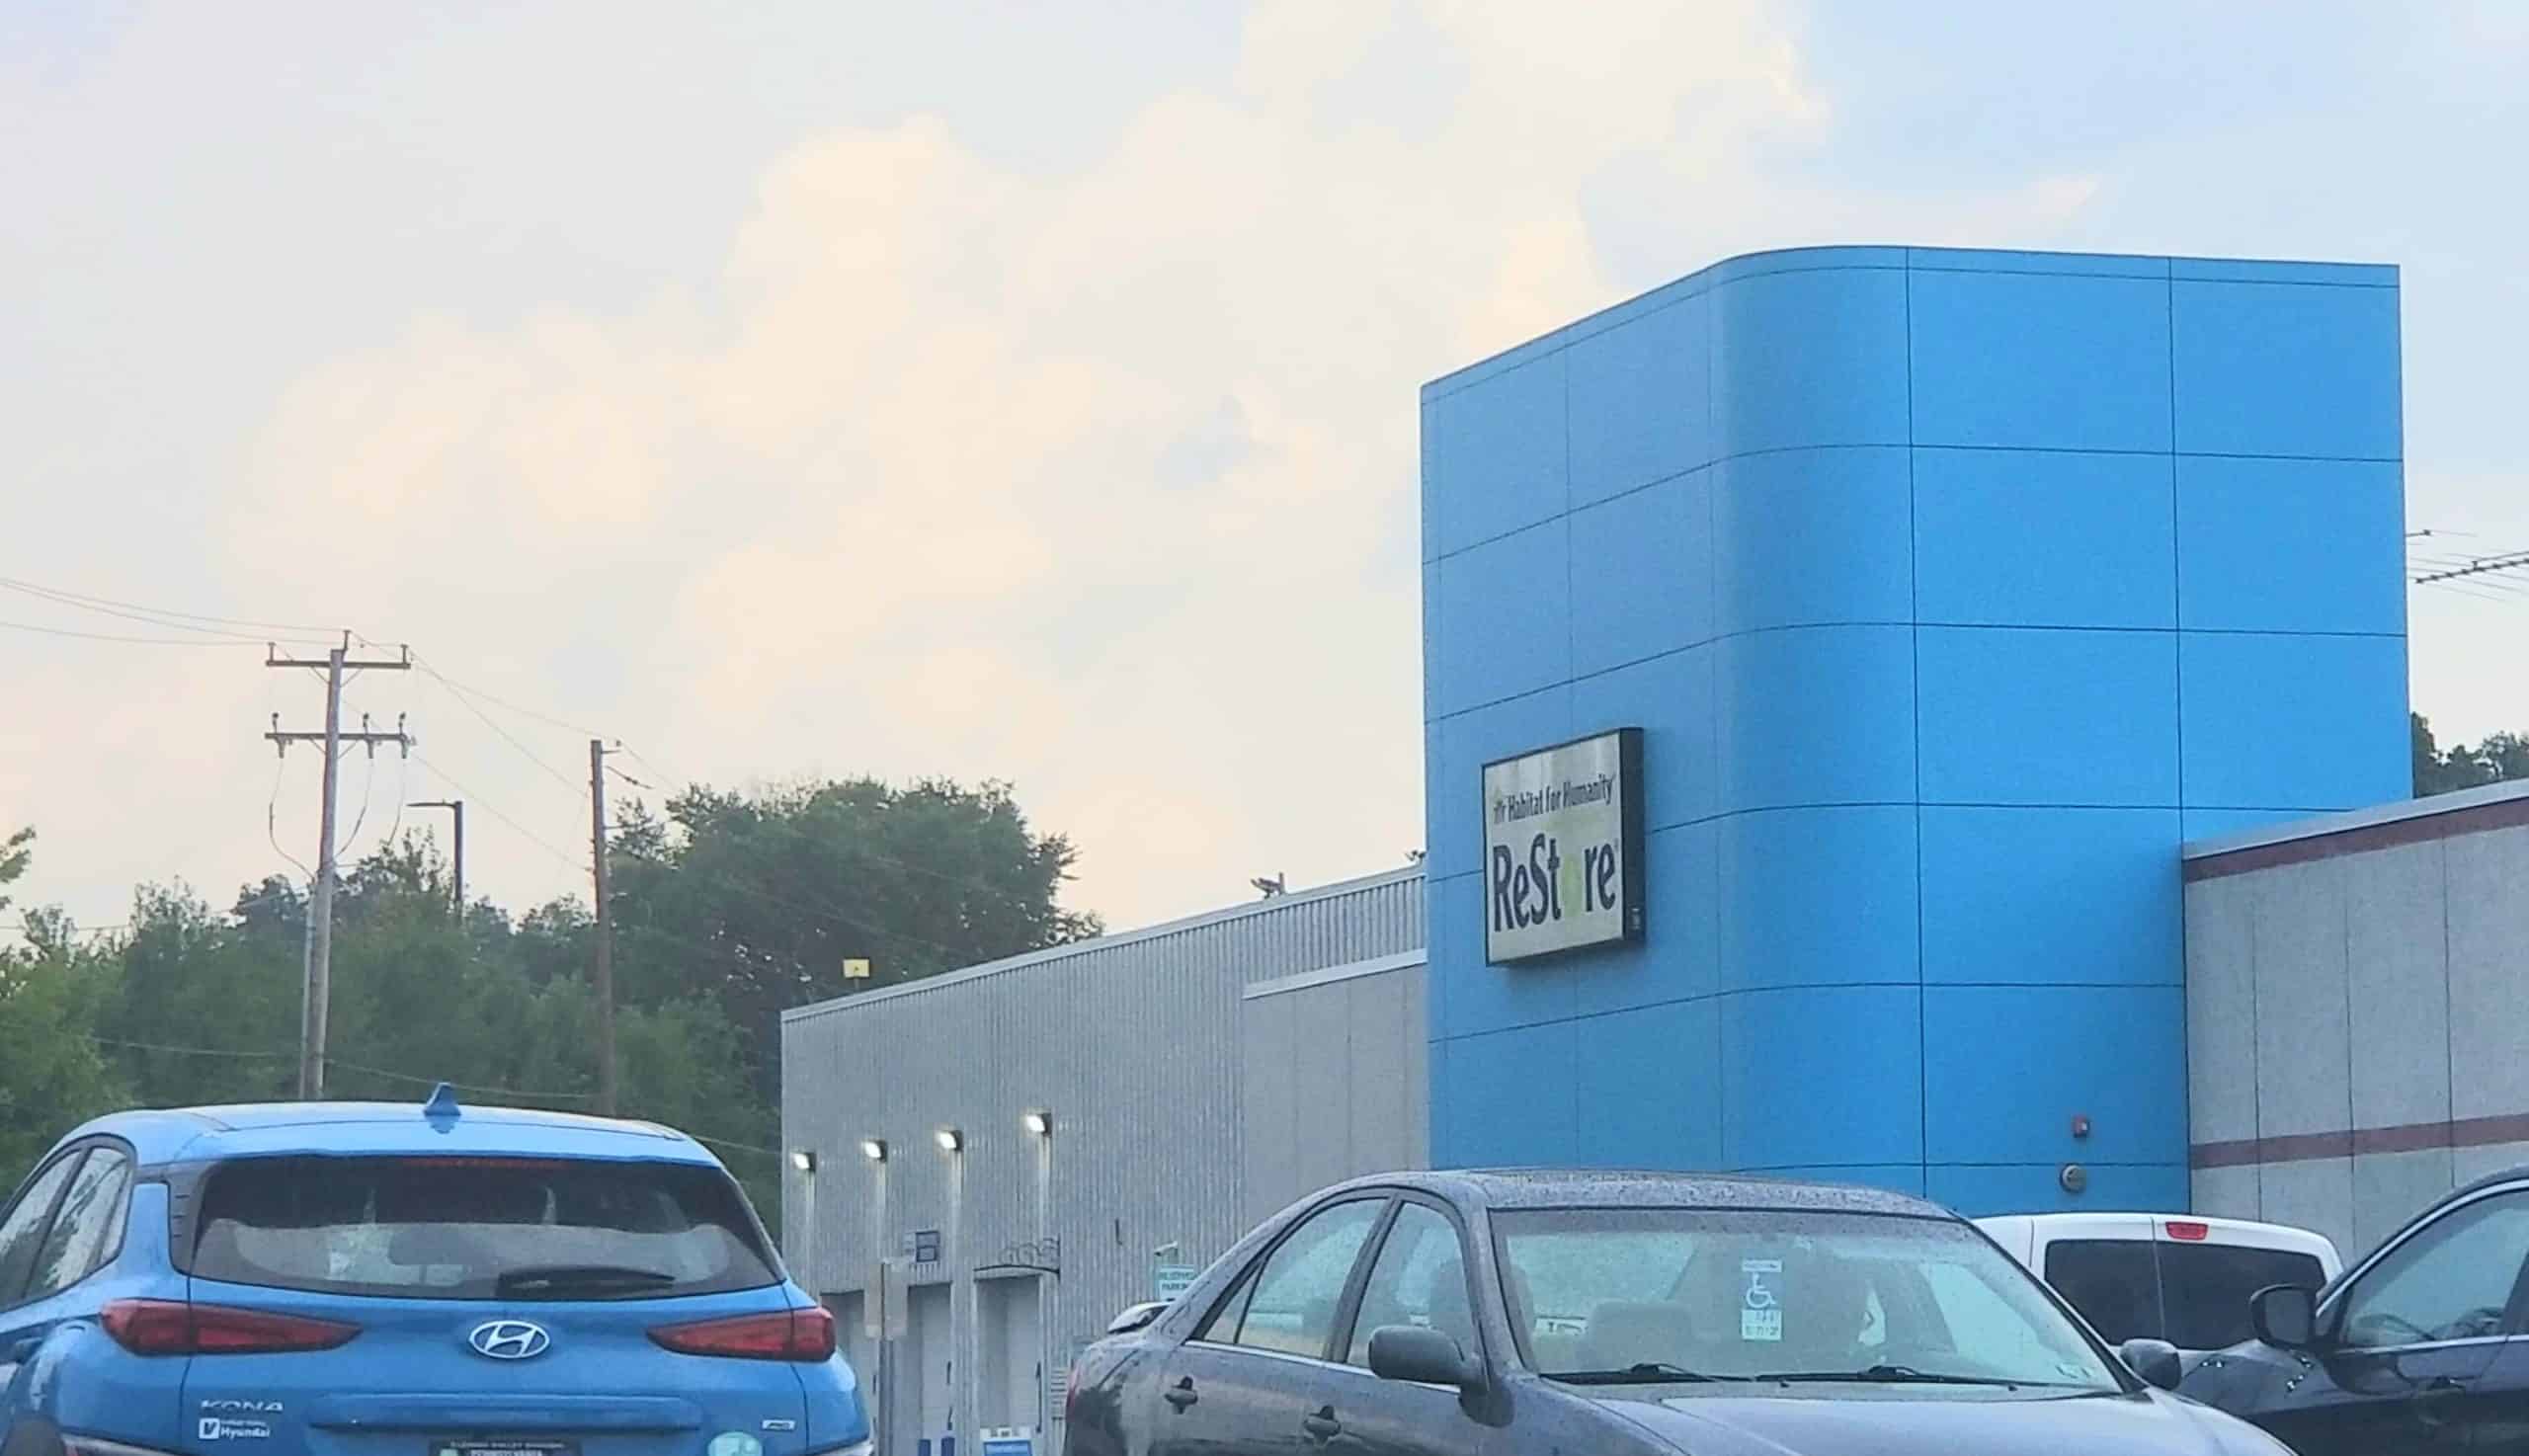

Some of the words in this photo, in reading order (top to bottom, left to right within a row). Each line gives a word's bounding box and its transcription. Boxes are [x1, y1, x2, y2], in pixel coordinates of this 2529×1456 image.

[1509, 790, 1543, 822] Habitat
[1545, 785, 1561, 813] for
[1563, 773, 1614, 807] Humanity
[1493, 833, 1615, 931] ReStre
[220, 1427, 271, 1441] Hyundai
